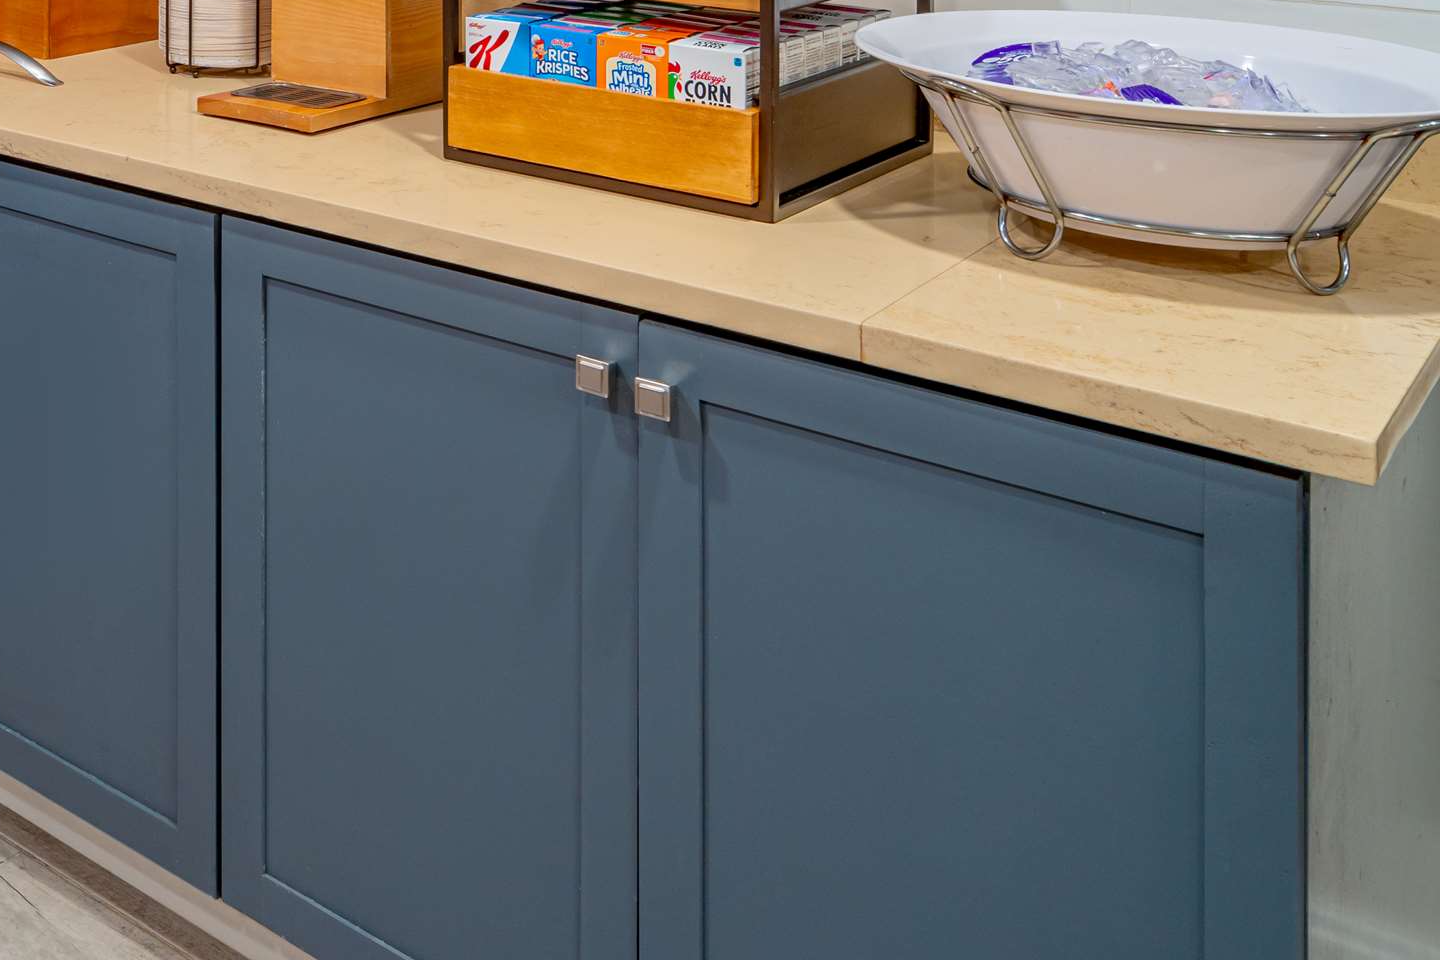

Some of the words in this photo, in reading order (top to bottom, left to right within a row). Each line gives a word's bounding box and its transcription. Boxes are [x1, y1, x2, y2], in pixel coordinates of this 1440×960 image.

[468, 29, 510, 71] K
[548, 48, 578, 65] RICE
[536, 61, 589, 81] KRISPIES
[618, 62, 644, 73] Frosted
[690, 69, 727, 83] Kellogg's
[613, 70, 649, 88] Mini
[685, 80, 731, 104] CORN
